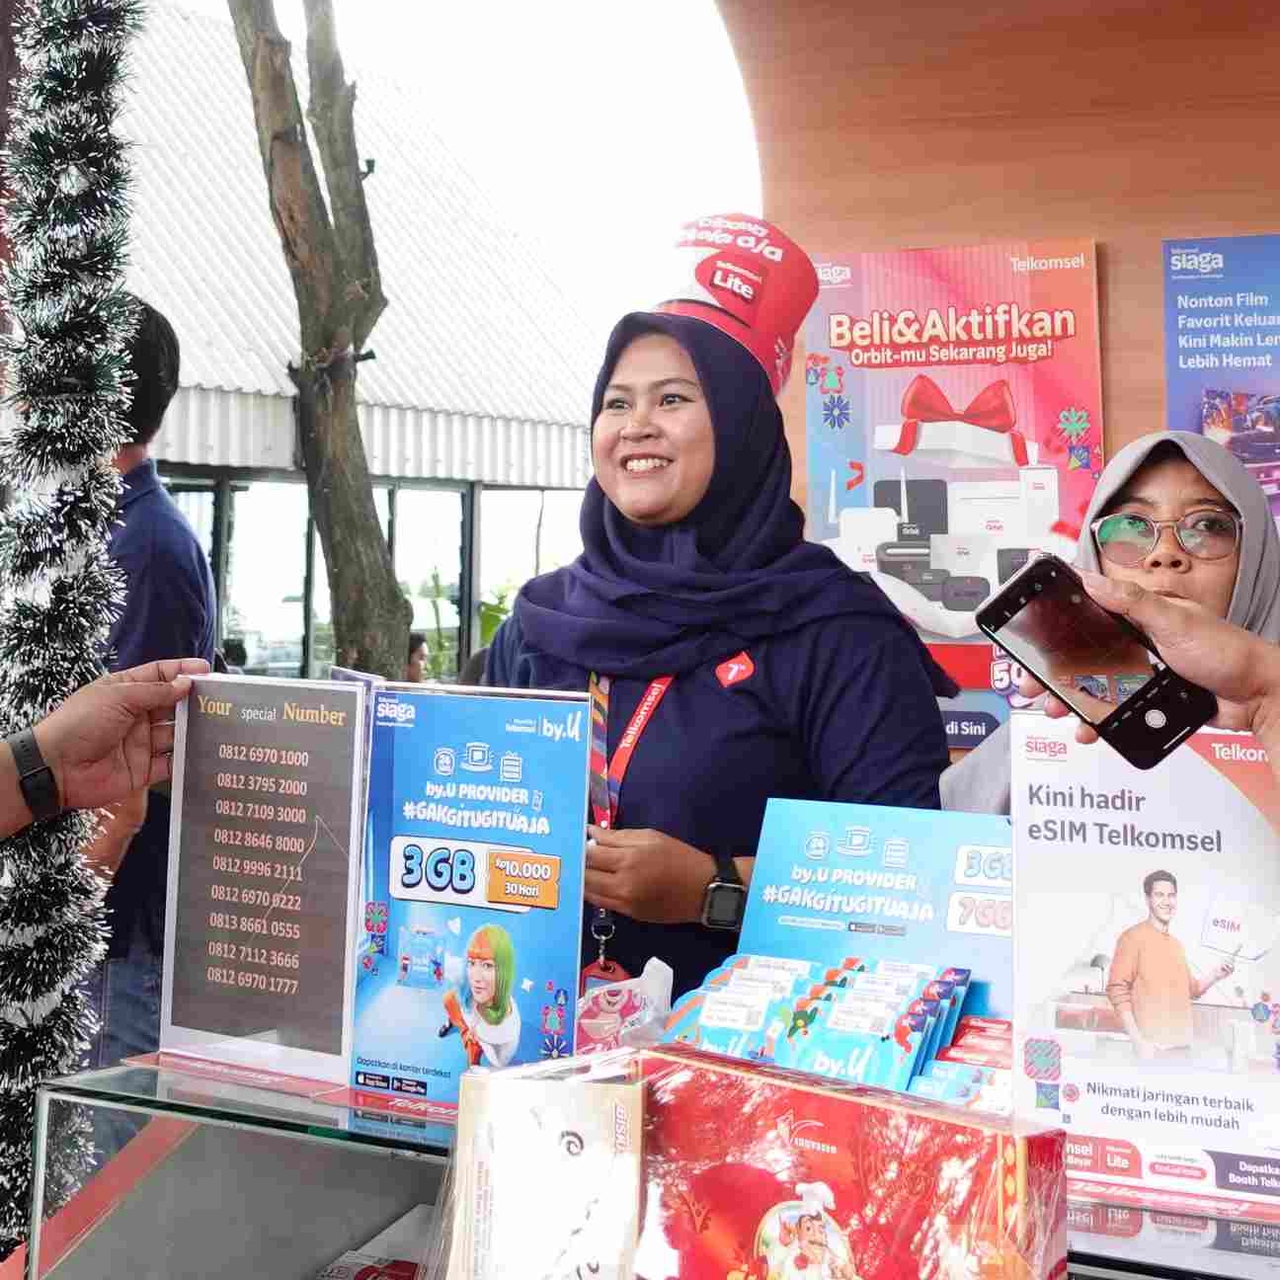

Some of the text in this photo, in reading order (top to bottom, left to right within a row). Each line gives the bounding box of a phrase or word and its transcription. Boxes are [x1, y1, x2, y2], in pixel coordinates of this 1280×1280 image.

[1010, 254, 1085, 273] Telkomsel
[713, 269, 754, 299] Lite
[1177, 292, 1269, 309] Nonton Film
[829, 303, 1075, 348] Beli&Aktifkan
[1178, 314, 1231, 329] Favorit
[851, 339, 1052, 365] Orbit-mu Sekarang Juga!
[1178, 334, 1207, 349] Kini
[1209, 332, 1254, 348] Makin
[1178, 353, 1273, 369] Lebih Hemat
[197, 694, 347, 726] Your special Number
[620, 682, 663, 749] Telkomsel
[542, 710, 582, 742] by.U
[946, 721, 987, 735] di Sini
[219, 743, 308, 766] 0812 6970 1000
[1211, 742, 1268, 762] Telko
[217, 772, 307, 796] 0812 3795 2000
[426, 781, 529, 805] by.U PROVIDER
[1028, 783, 1146, 812] Kini hadir
[215, 799, 306, 823] 0812 7109 3000
[213, 828, 304, 853] 0812 8646 8000
[1028, 819, 1222, 853] eSIM Telkomsel
[212, 856, 303, 881] 0812 9996 2111
[401, 843, 476, 894] 3GB
[791, 865, 917, 891] by.U PROVIDER
[211, 884, 239, 902] 0812
[241, 889, 270, 906] 6970
[505, 881, 539, 898] 30 Hari
[209, 912, 300, 939] 0813 8661 0555
[208, 941, 300, 969] 0812 7112 3666
[206, 967, 298, 994] 0812 6970 1777
[387, 1097, 459, 1115] Telko
[1086, 1082, 1254, 1113] Nikmati jaringan terbaik
[1101, 1102, 1240, 1131] dengan lebih mudah
[1228, 1174, 1258, 1186] Booth
